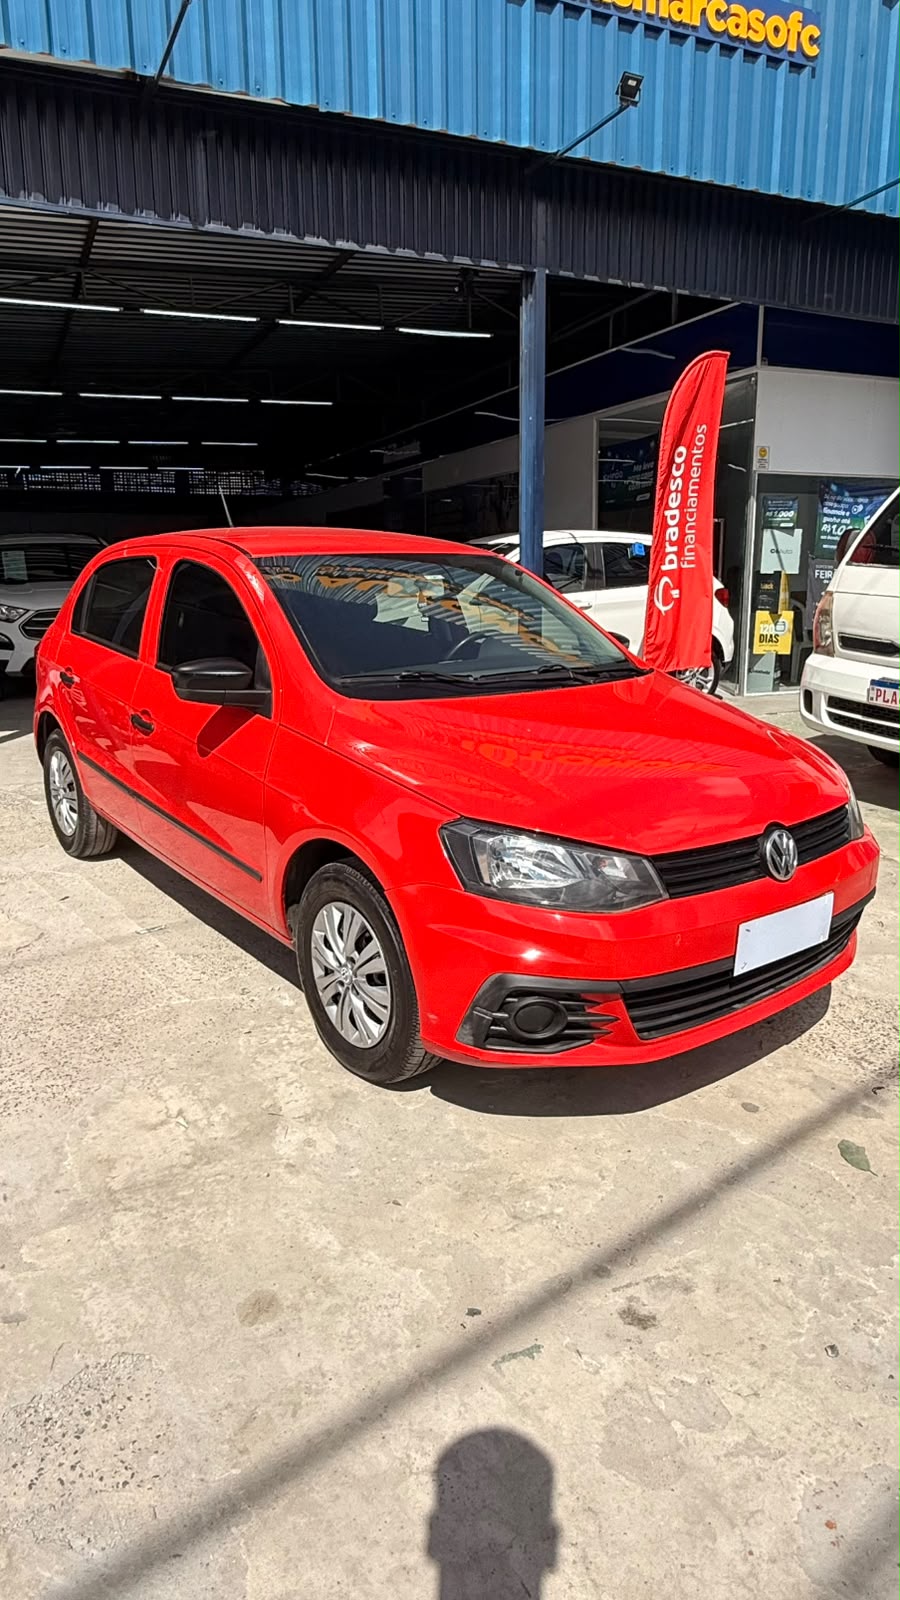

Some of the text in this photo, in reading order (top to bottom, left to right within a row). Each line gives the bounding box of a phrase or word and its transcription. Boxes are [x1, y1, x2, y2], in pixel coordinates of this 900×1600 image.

[680, 424, 708, 569] financiamentos
[660, 445, 688, 571] bradesco
[759, 623, 776, 634] 120
[759, 633, 780, 644] DIAS
[875, 688, 900, 705] PLA
